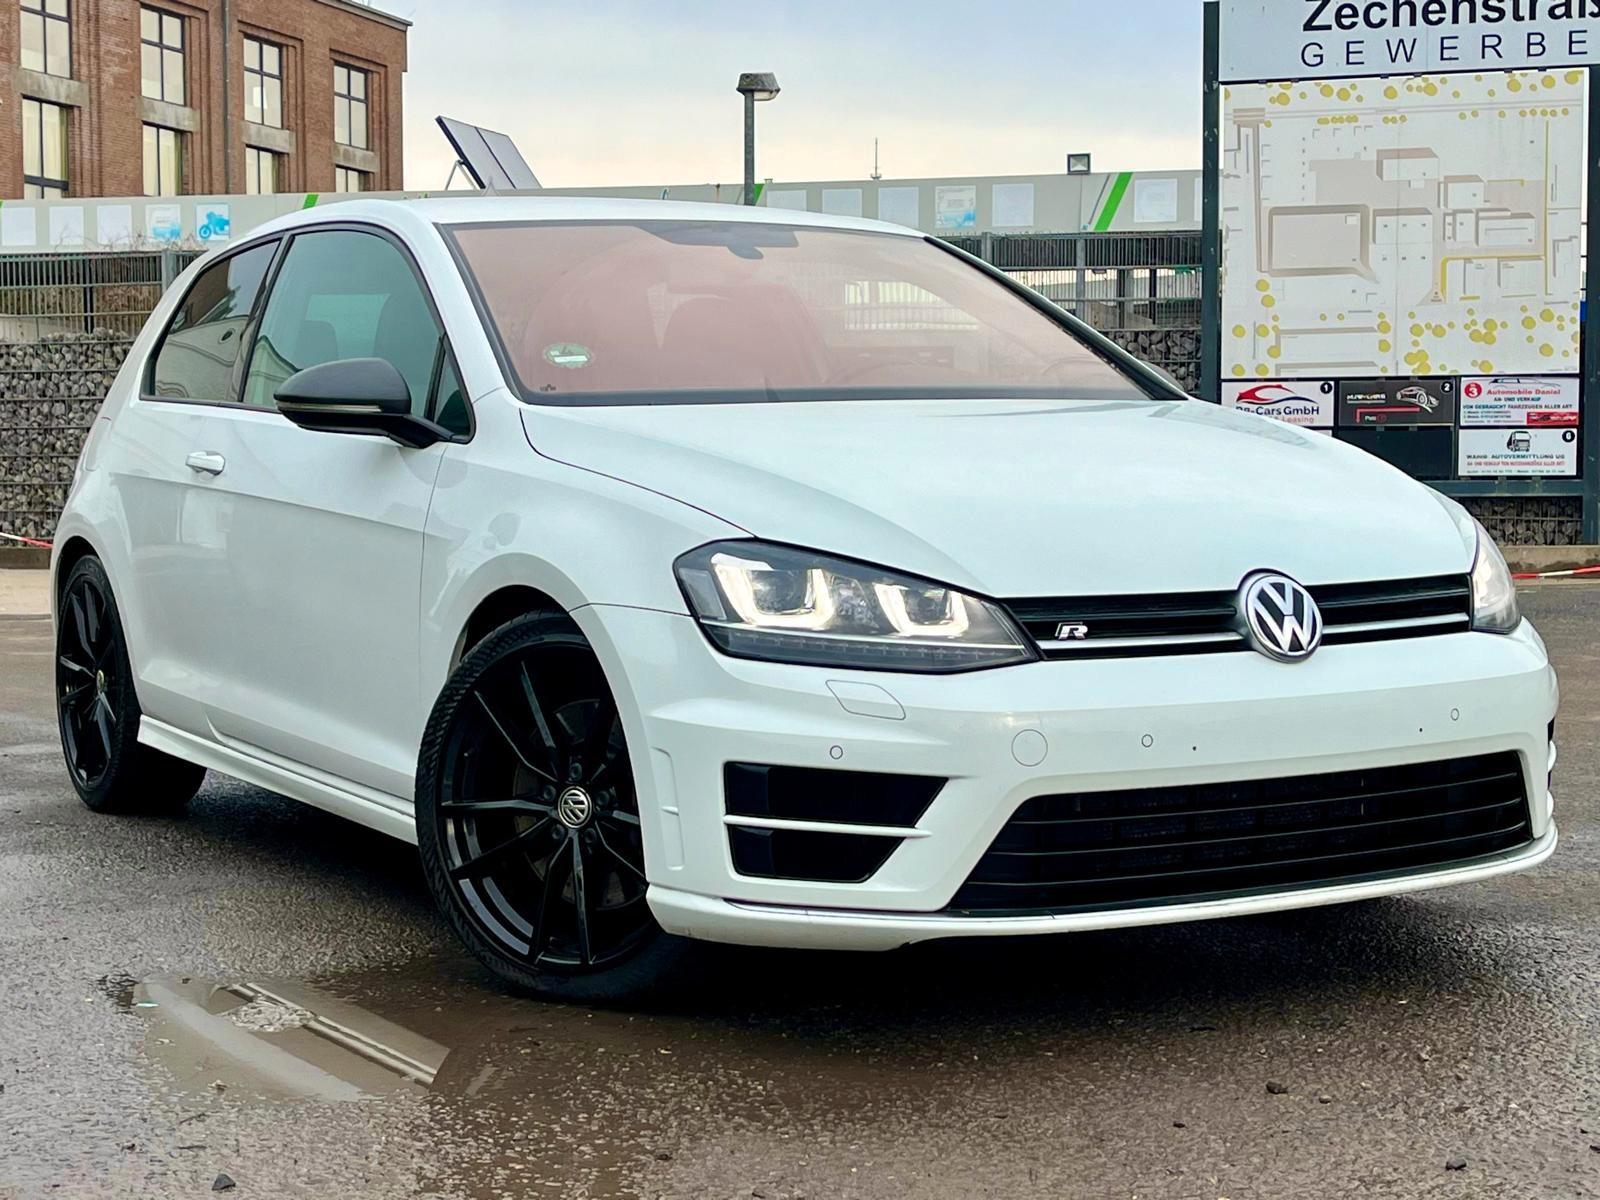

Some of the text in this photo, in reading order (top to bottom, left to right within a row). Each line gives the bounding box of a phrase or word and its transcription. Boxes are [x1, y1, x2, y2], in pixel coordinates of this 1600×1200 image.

[1301, 30, 1588, 67] GEWERBE
[1468, 387, 1478, 397] 3
[1283, 405, 1320, 415] GmbH
[1055, 621, 1088, 640] R
